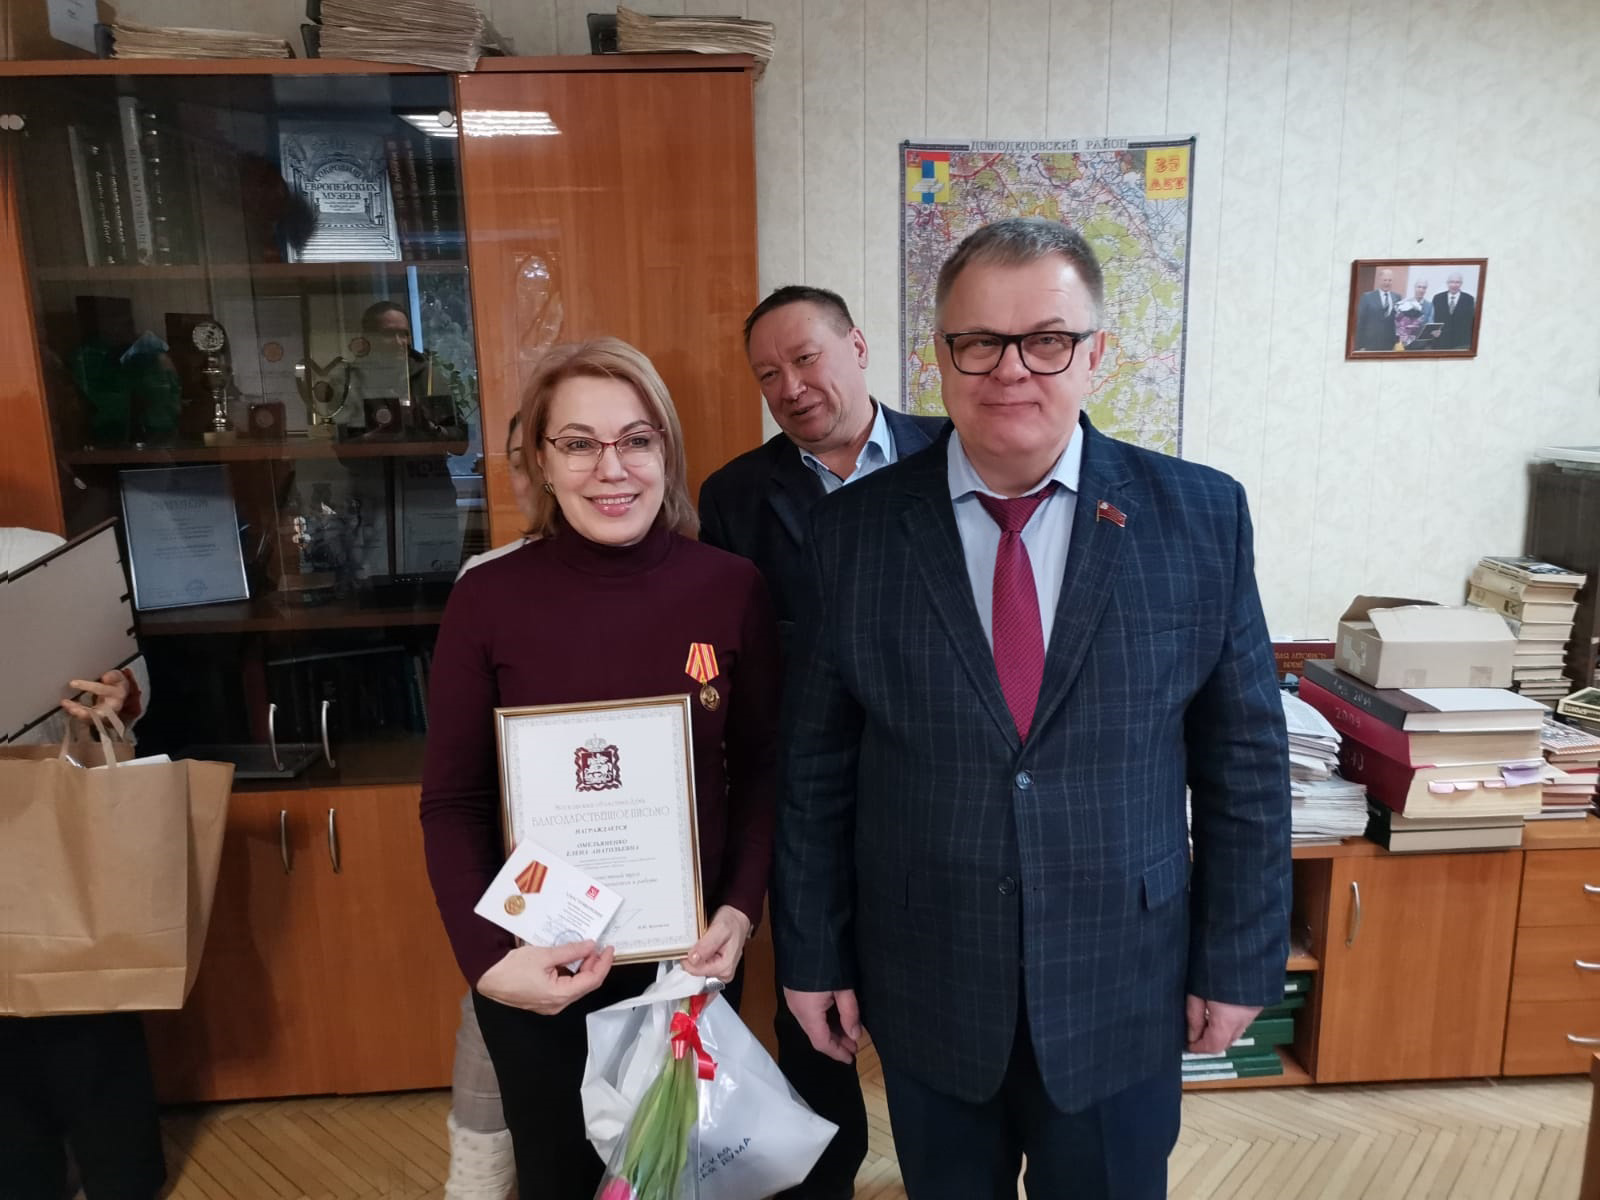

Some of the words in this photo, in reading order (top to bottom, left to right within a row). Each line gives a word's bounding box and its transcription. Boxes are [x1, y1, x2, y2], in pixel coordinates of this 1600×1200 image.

[1086, 138, 1128, 150] РАЙОН
[303, 181, 379, 192] ЕВРОПЕЙСКИХ
[322, 192, 362, 200] МУЗЕЕВ
[531, 810, 629, 826] БЛАГОДАРСТВЕННОЕ
[631, 806, 670, 819] ПИСЬМО
